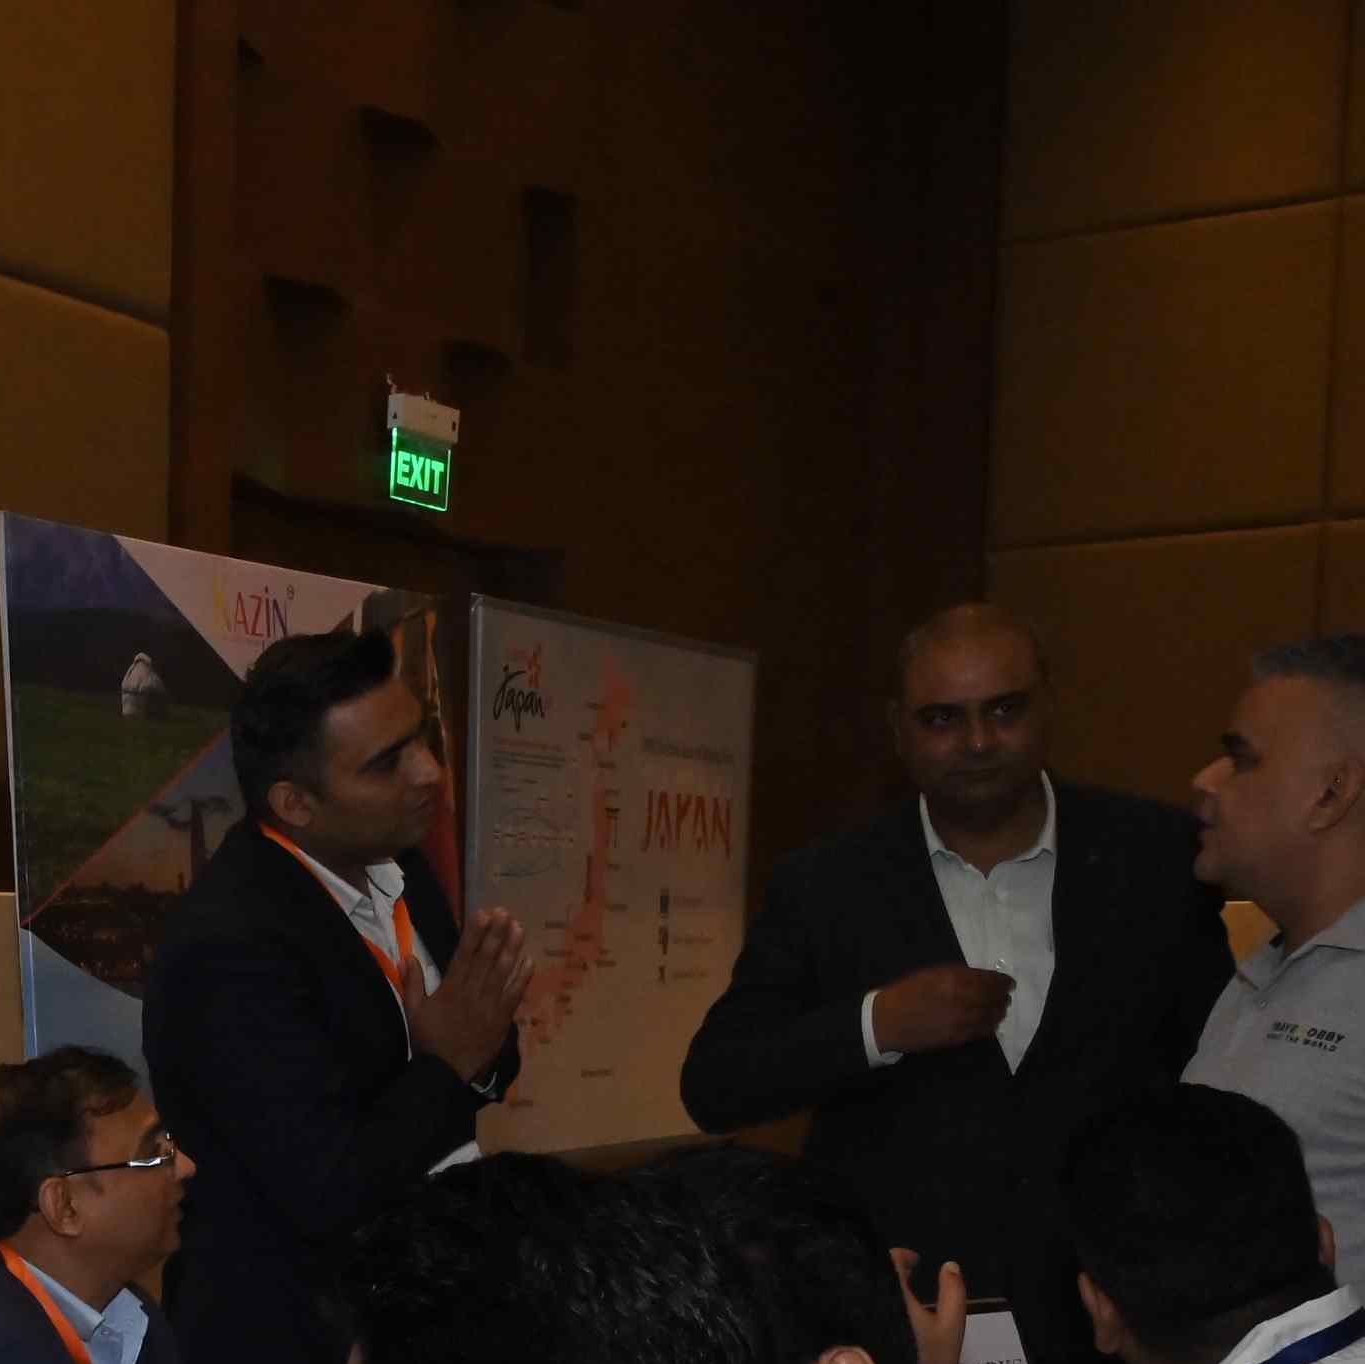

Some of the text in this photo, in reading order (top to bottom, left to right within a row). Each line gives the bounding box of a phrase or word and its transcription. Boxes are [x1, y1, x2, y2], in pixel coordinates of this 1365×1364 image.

[397, 450, 445, 494] EXIT
[493, 664, 545, 733] Japan
[642, 788, 733, 860] JAPAN
